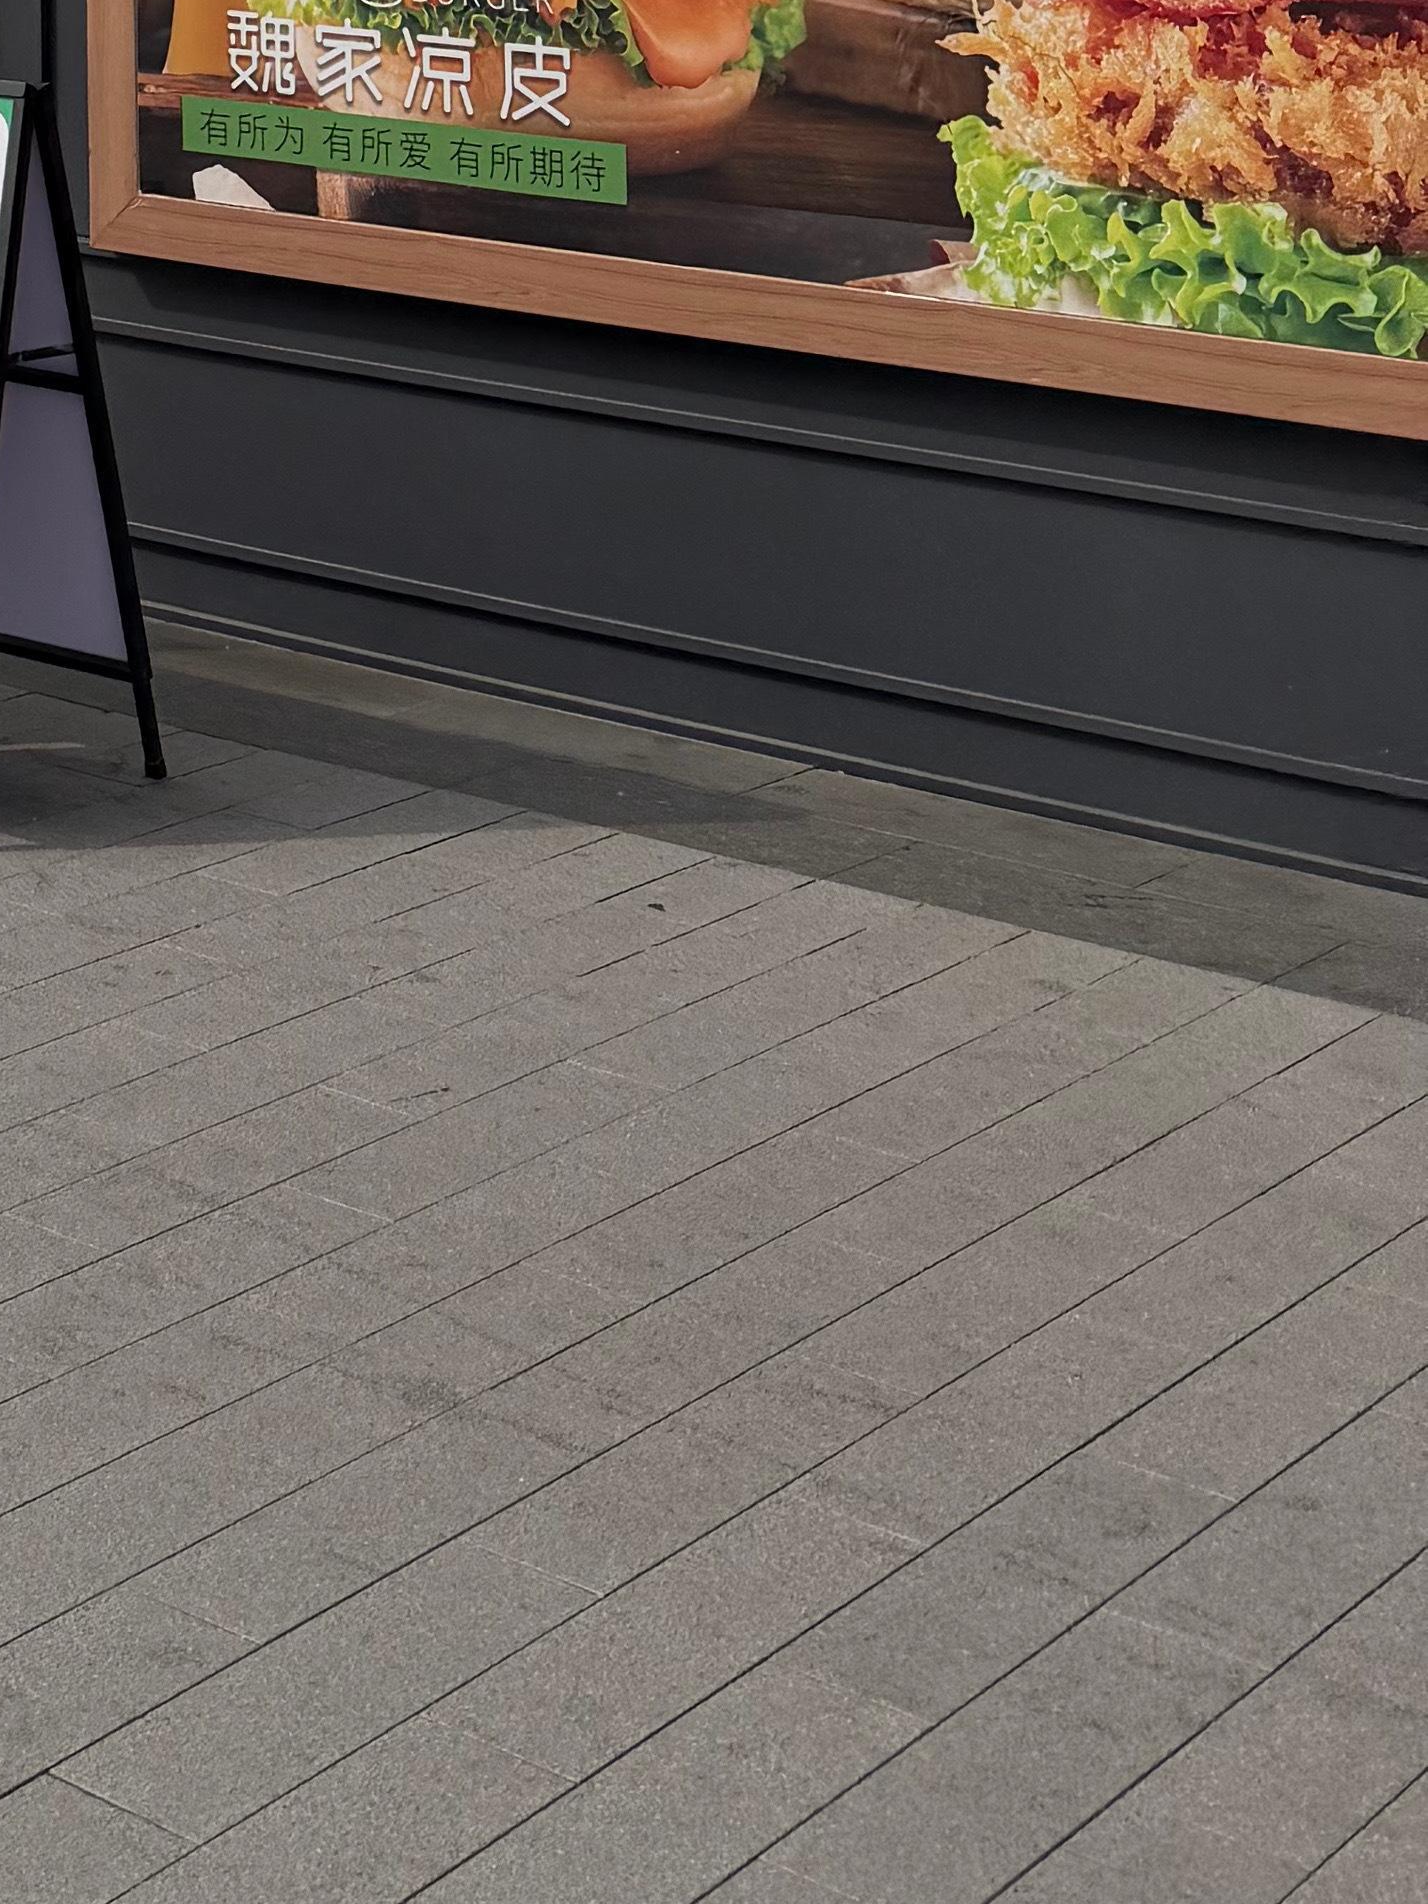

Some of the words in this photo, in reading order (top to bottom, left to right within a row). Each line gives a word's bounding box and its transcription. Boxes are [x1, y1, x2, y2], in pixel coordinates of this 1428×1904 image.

[226, 8, 572, 127] 魏家凉皮
[199, 107, 305, 156] 有所为
[321, 121, 432, 172] 有所爱
[449, 136, 607, 193] 有所期待
